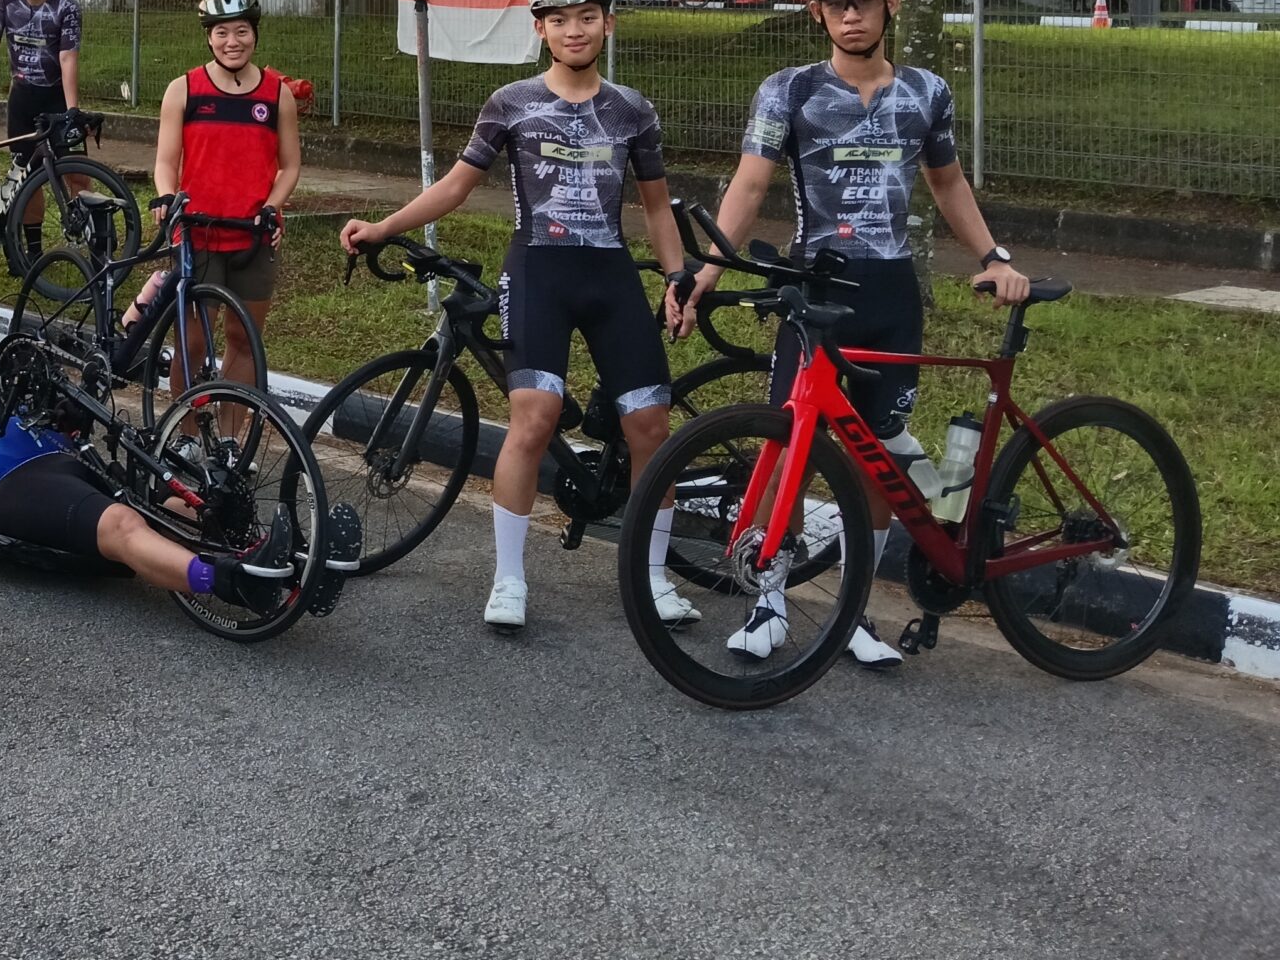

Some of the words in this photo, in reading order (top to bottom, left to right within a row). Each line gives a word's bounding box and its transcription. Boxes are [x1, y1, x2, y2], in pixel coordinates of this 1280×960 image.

[521, 132, 566, 143] VIRTUAL
[812, 138, 860, 146] VIRTUAL
[849, 167, 900, 176] TRAINING
[558, 174, 597, 185] PEAKS
[849, 175, 885, 184] PEAKS
[841, 186, 885, 200] ECO
[835, 415, 929, 525] GIANT
